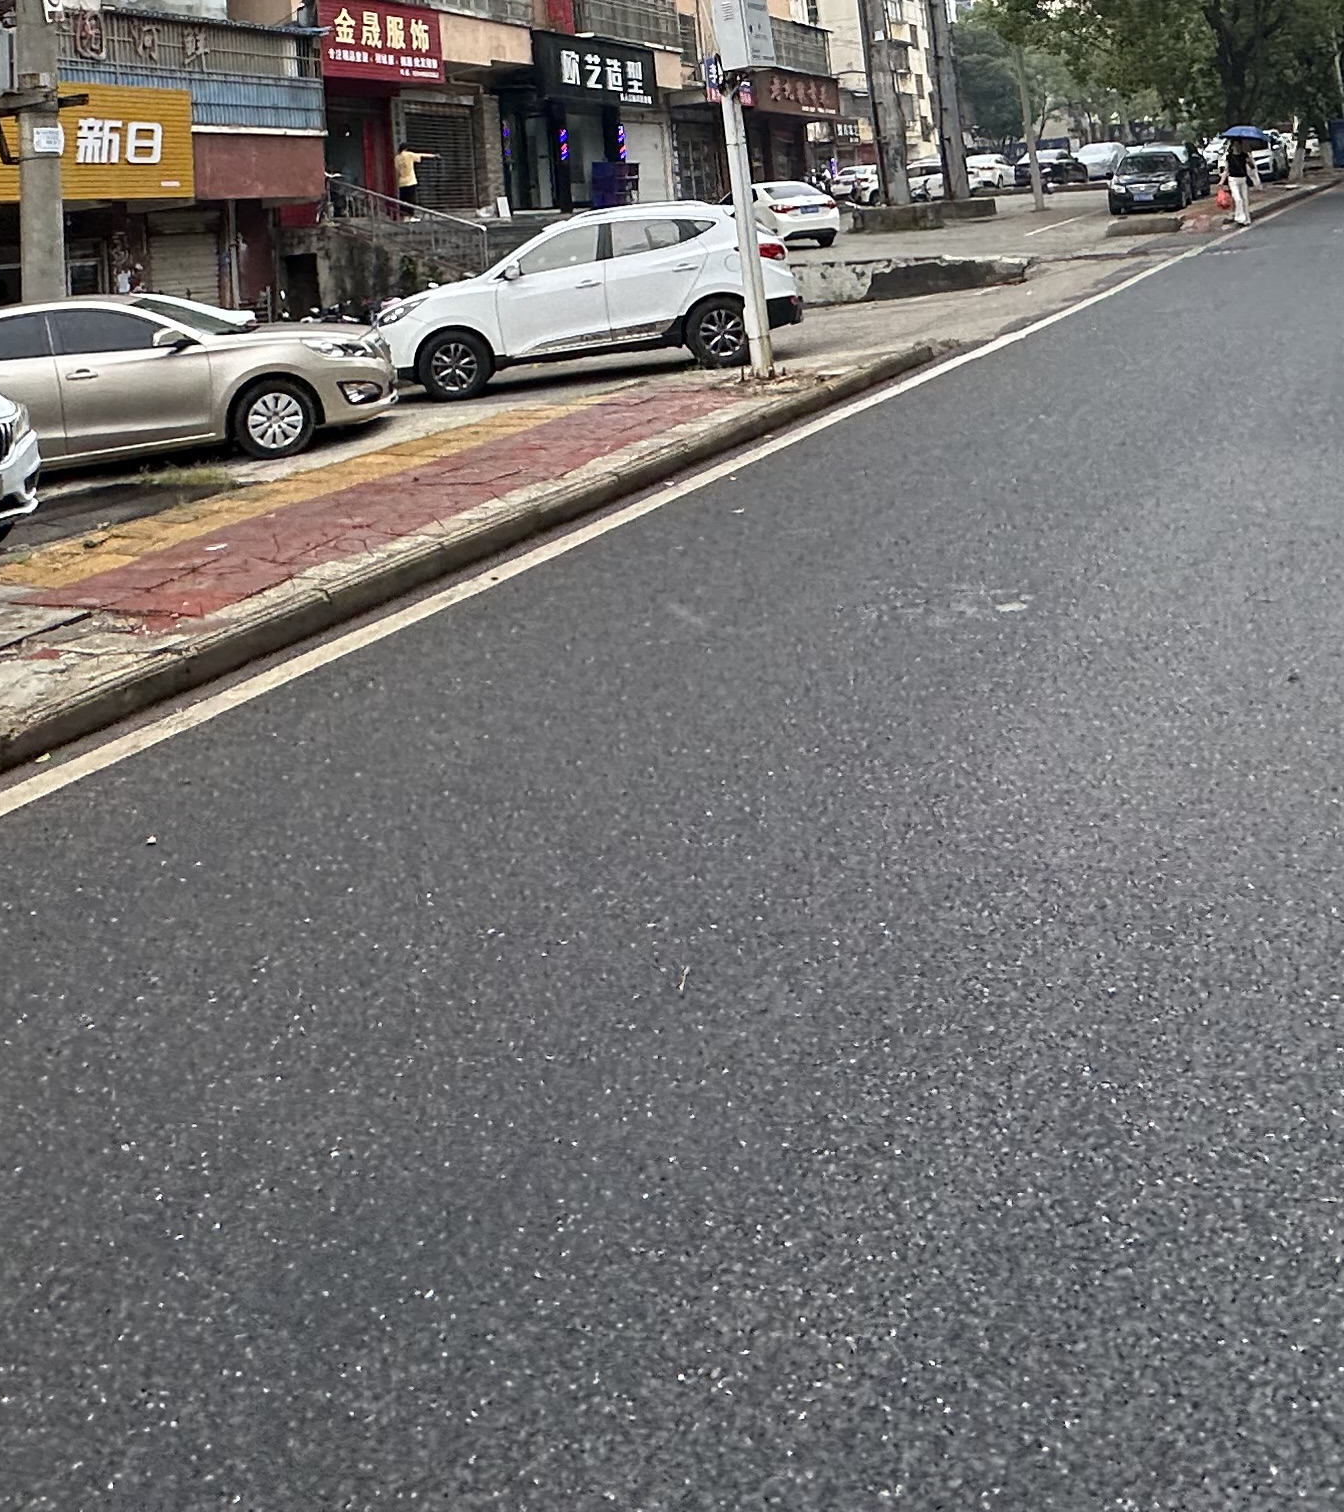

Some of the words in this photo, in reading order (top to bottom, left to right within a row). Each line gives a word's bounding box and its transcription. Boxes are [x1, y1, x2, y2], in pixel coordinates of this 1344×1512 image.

[333, 7, 431, 53] 金晟服饰
[75, 118, 163, 165] 新日
